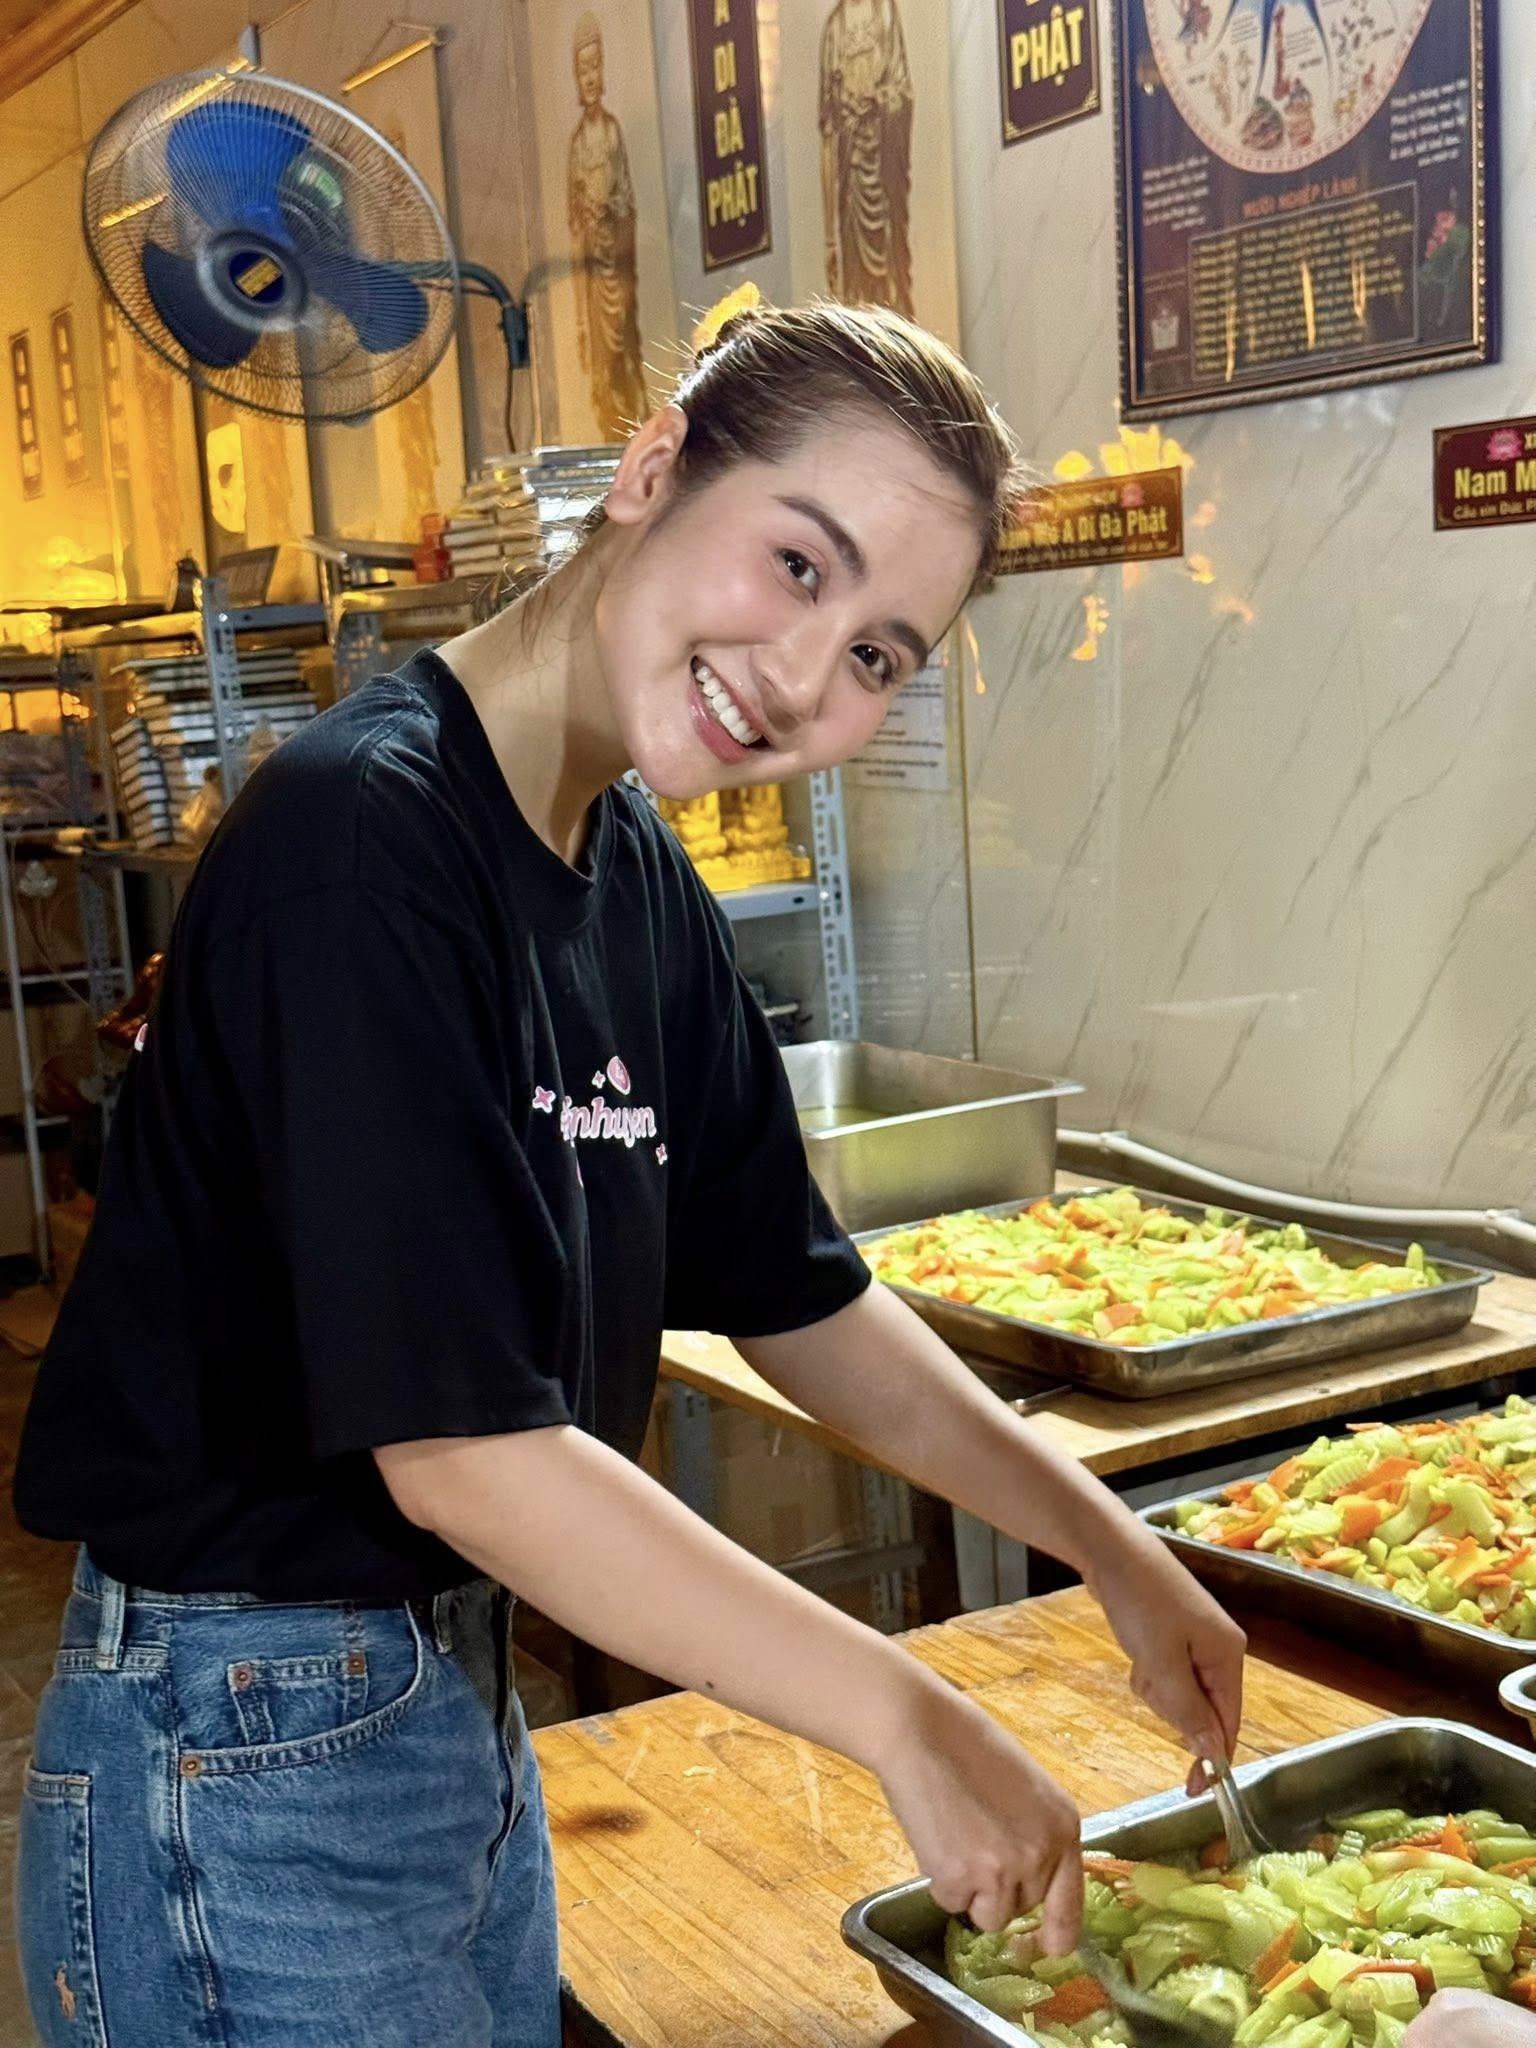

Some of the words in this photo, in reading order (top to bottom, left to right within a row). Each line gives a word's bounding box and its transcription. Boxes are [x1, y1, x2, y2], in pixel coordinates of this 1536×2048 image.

[714, 41, 737, 93] DI
[1010, 4, 1084, 91] PHẬT
[714, 96, 744, 158] ĐÀ
[706, 160, 759, 228] PHẬT
[1454, 466, 1507, 499] Nam
[1515, 458, 1536, 493] M
[1062, 518, 1075, 544] A
[1126, 506, 1168, 540] Phật
